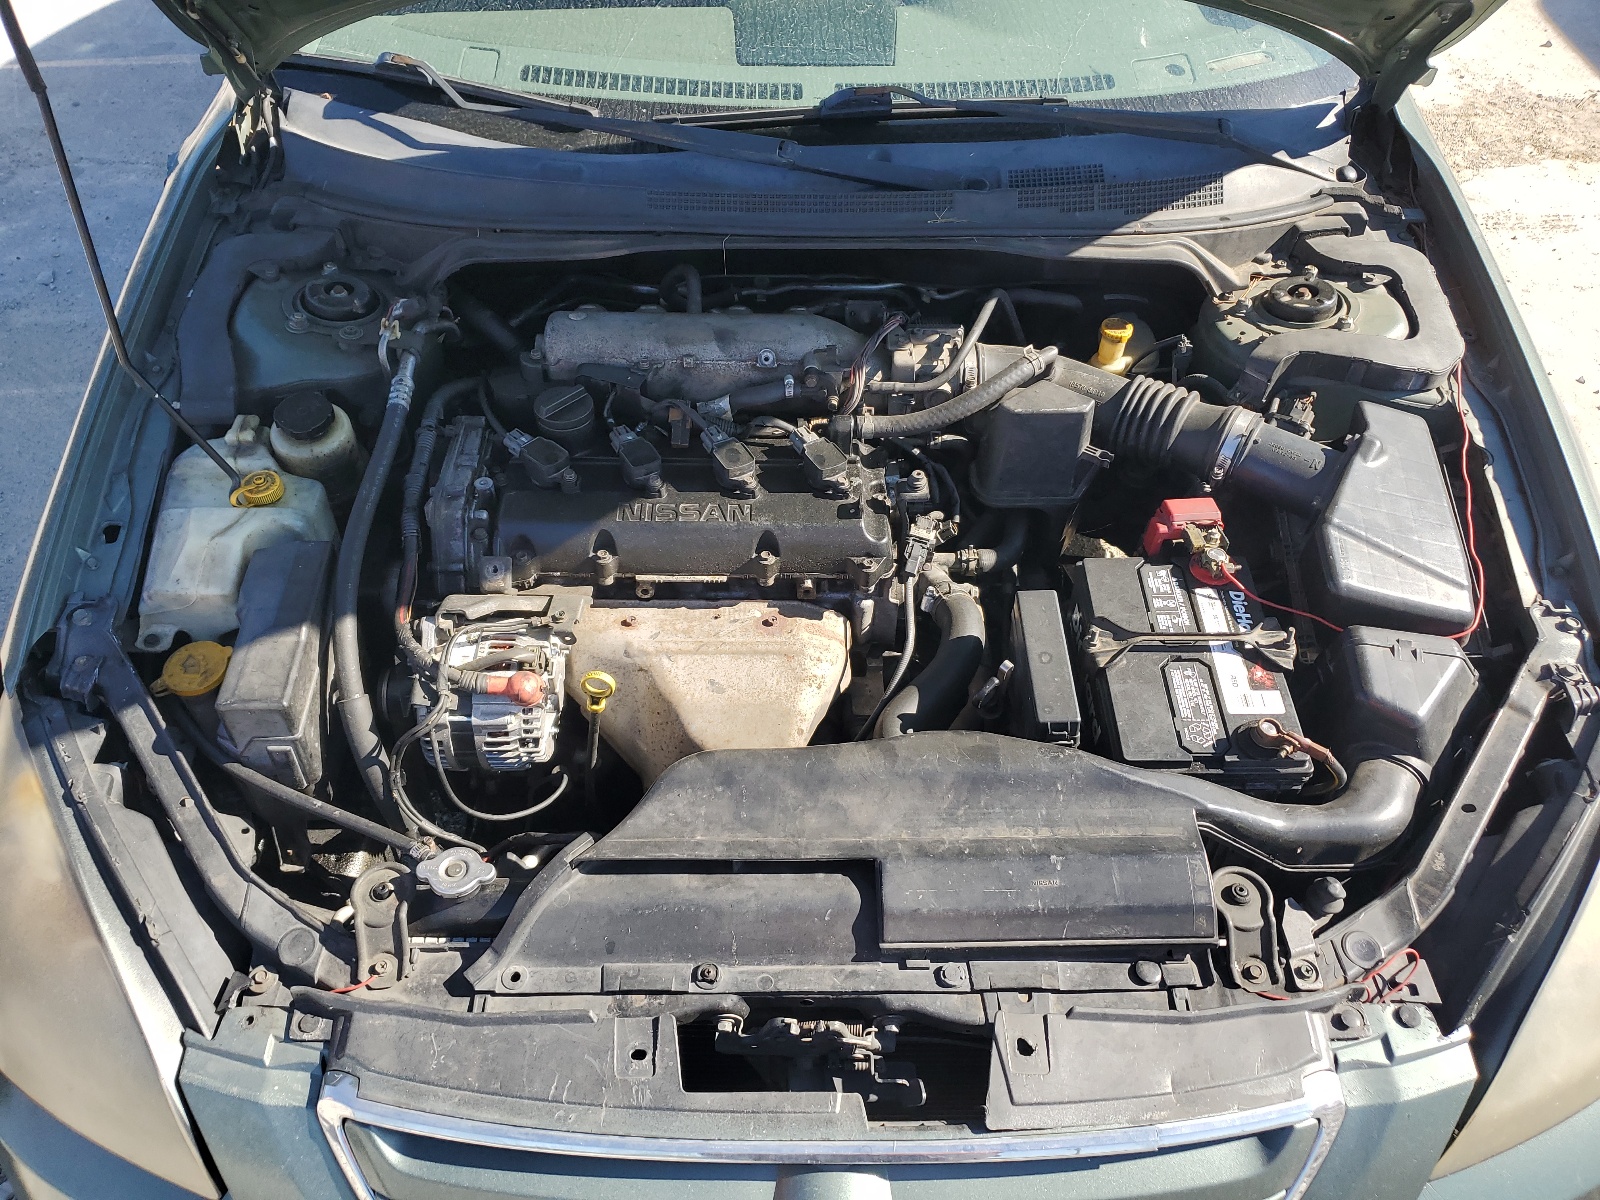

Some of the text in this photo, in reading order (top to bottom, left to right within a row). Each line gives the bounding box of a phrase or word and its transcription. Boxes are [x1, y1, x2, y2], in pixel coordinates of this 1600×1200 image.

[616, 503, 753, 522] NISSAN
[1228, 590, 1254, 648] DieHa
[1031, 879, 1059, 888] NISSAN
